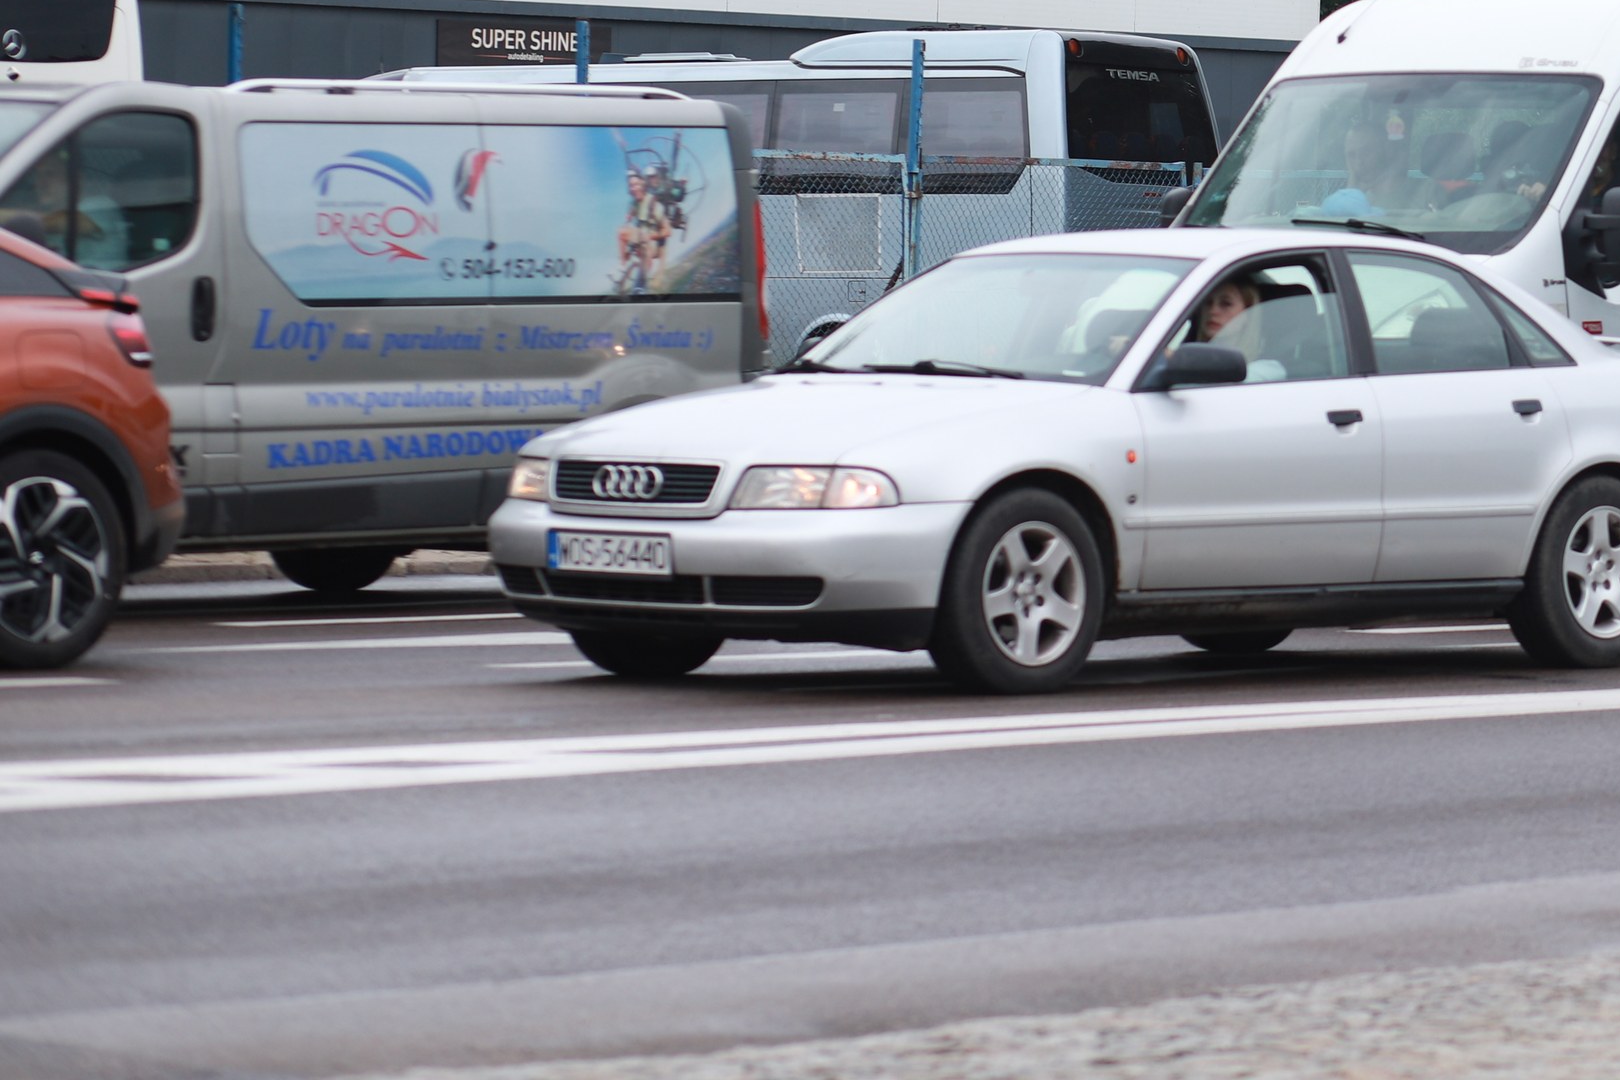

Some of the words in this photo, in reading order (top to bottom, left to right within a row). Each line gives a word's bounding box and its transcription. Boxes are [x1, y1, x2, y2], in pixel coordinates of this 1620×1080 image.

[471, 27, 526, 50] SUPER
[530, 30, 578, 52] SHINE
[507, 52, 544, 63] autodetailing
[1105, 68, 1160, 82] TEMSA
[316, 206, 438, 239] DRAGON
[461, 257, 576, 280] 504-152-600
[252, 308, 337, 361] Loty
[342, 332, 371, 350] na
[379, 325, 484, 357] paralotni
[624, 316, 691, 349] Świata
[266, 438, 377, 469] KADRA
[382, 428, 545, 461] NARODOW
